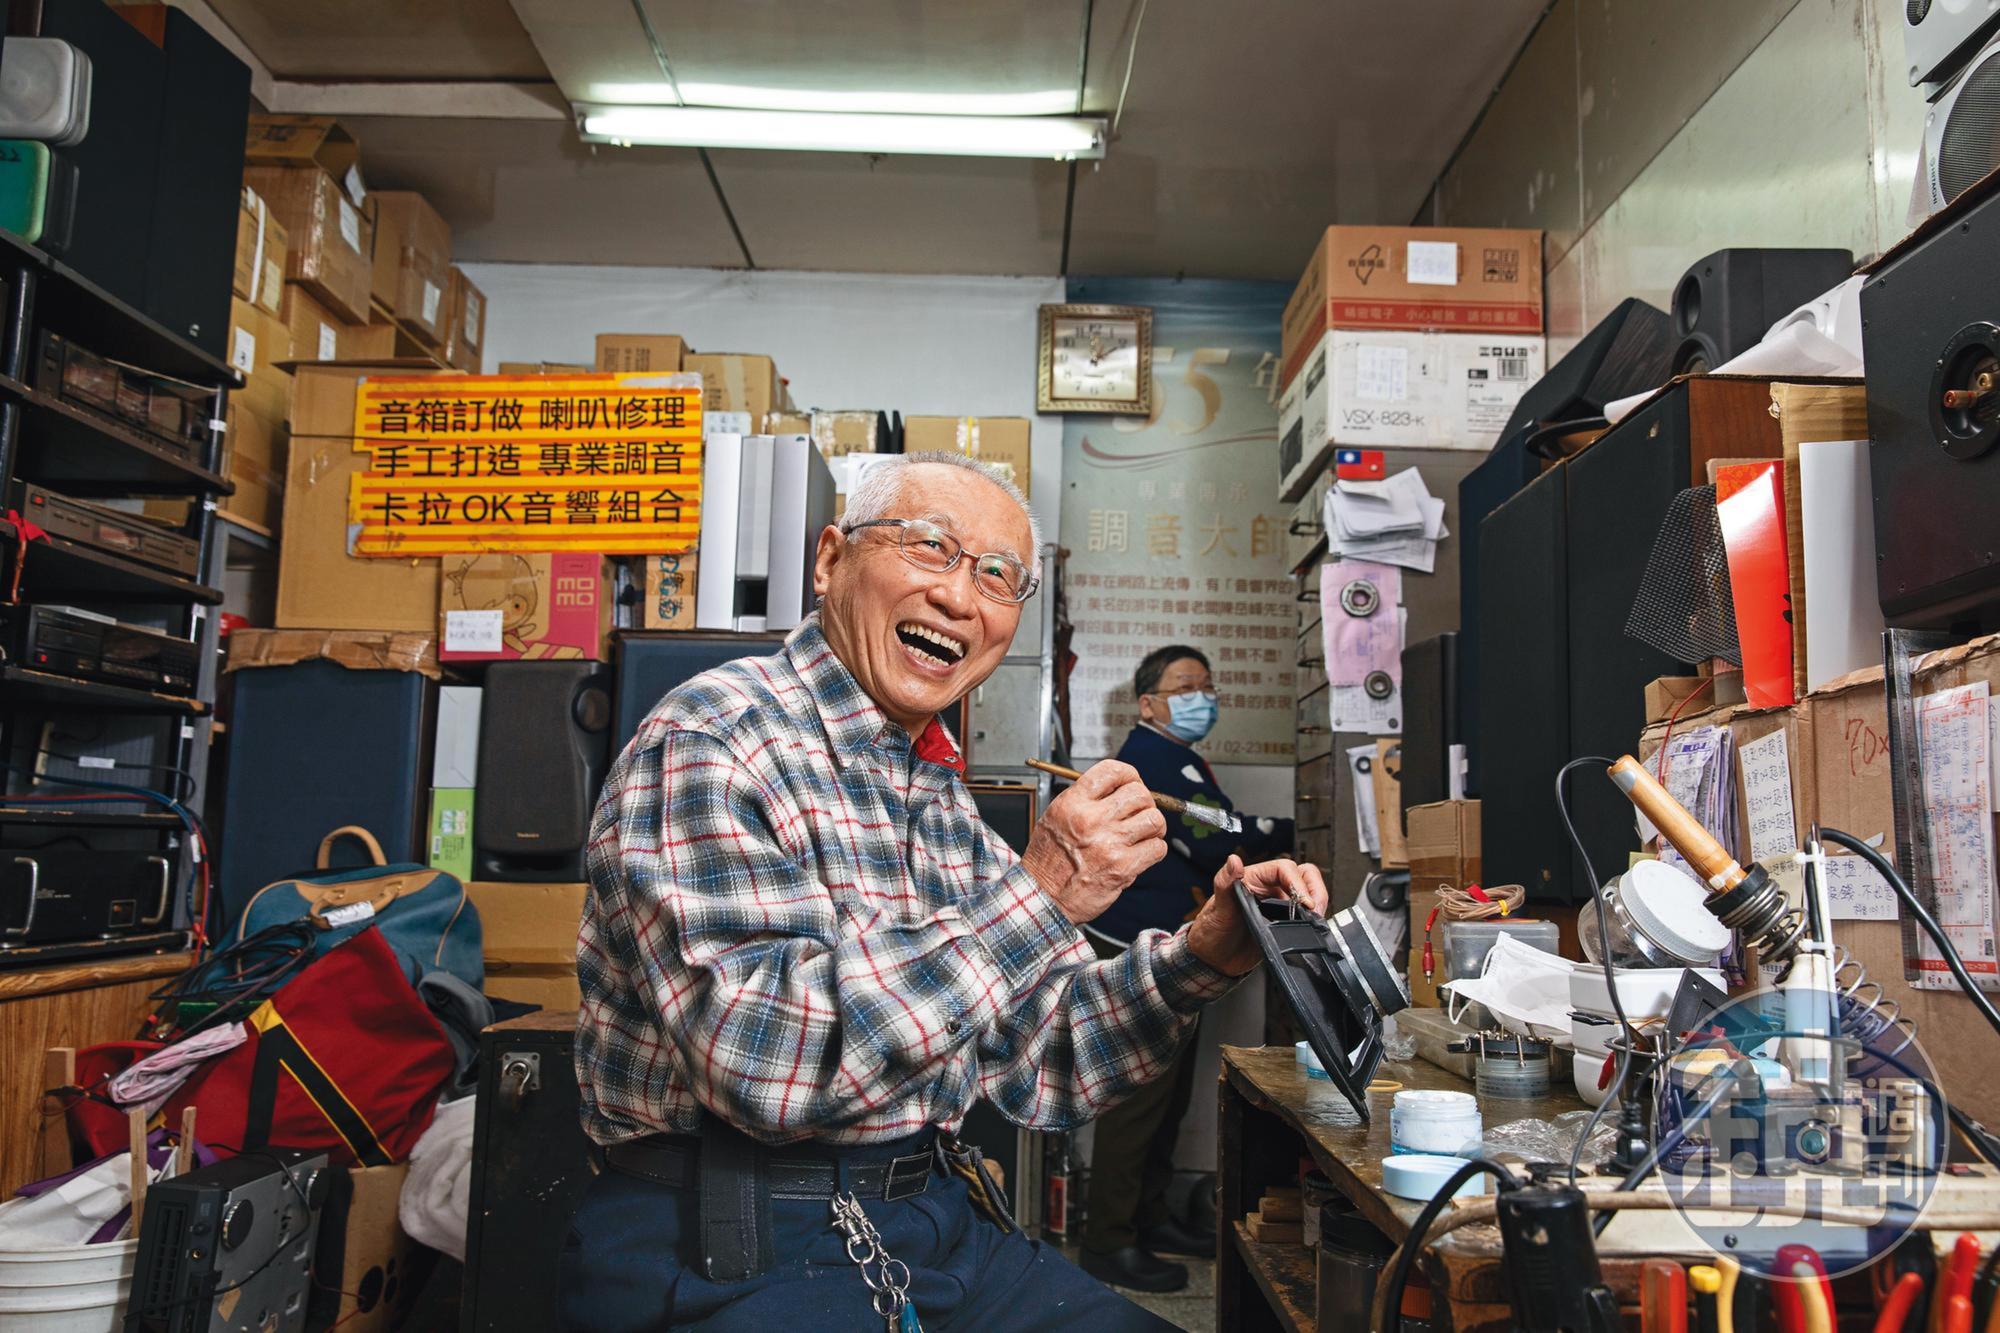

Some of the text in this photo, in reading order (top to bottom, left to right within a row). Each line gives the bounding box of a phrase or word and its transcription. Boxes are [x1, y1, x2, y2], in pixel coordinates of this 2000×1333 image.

[378, 398, 522, 433] 音箱訂做
[538, 396, 686, 430] 喇叭修理
[1343, 408, 1425, 427] VSX-823-K
[375, 441, 686, 478] 手工打造 專業調音
[373, 489, 685, 527] 卡拉OK音響組合
[1088, 509, 1290, 561] 調音大師
